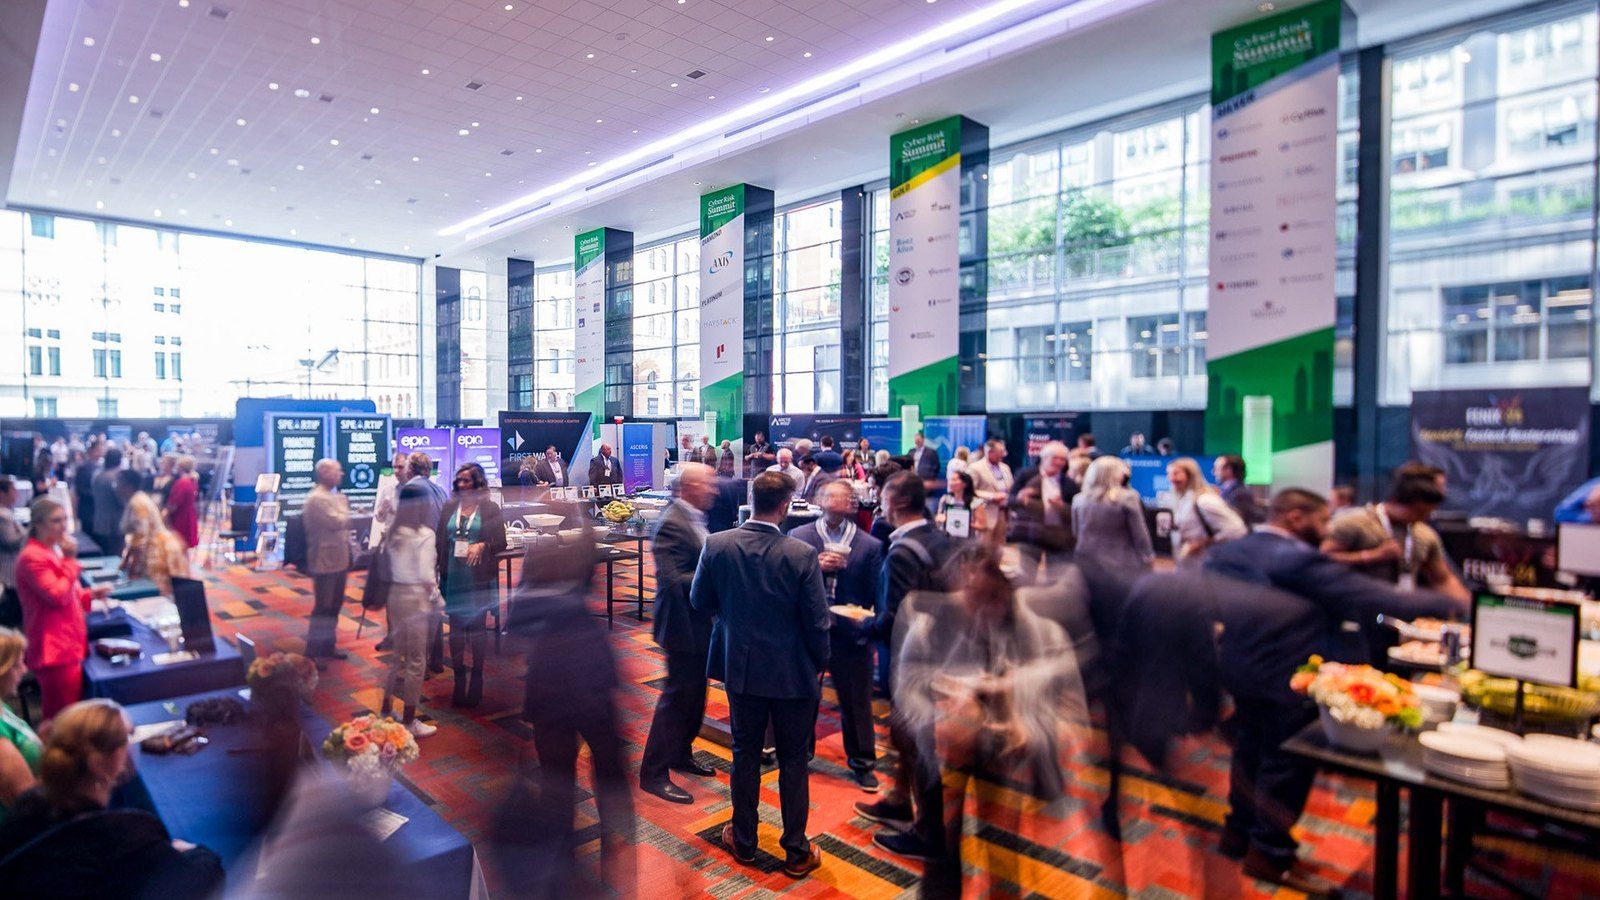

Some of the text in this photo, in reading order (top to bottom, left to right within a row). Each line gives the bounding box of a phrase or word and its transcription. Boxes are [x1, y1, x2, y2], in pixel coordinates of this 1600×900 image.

[1233, 32, 1312, 60] Summit
[902, 130, 945, 149] Cyber Risk
[902, 140, 946, 158] Summit
[893, 183, 911, 198] GOLD
[708, 194, 735, 208] Cyber Risk
[707, 202, 736, 215] Summit
[702, 229, 722, 246] DIAMOND
[580, 242, 599, 252] Summit
[714, 257, 730, 269] AXIS
[701, 291, 723, 307] PLATINUM
[704, 318, 738, 328] HAYSTACK
[533, 452, 561, 461] WAH
